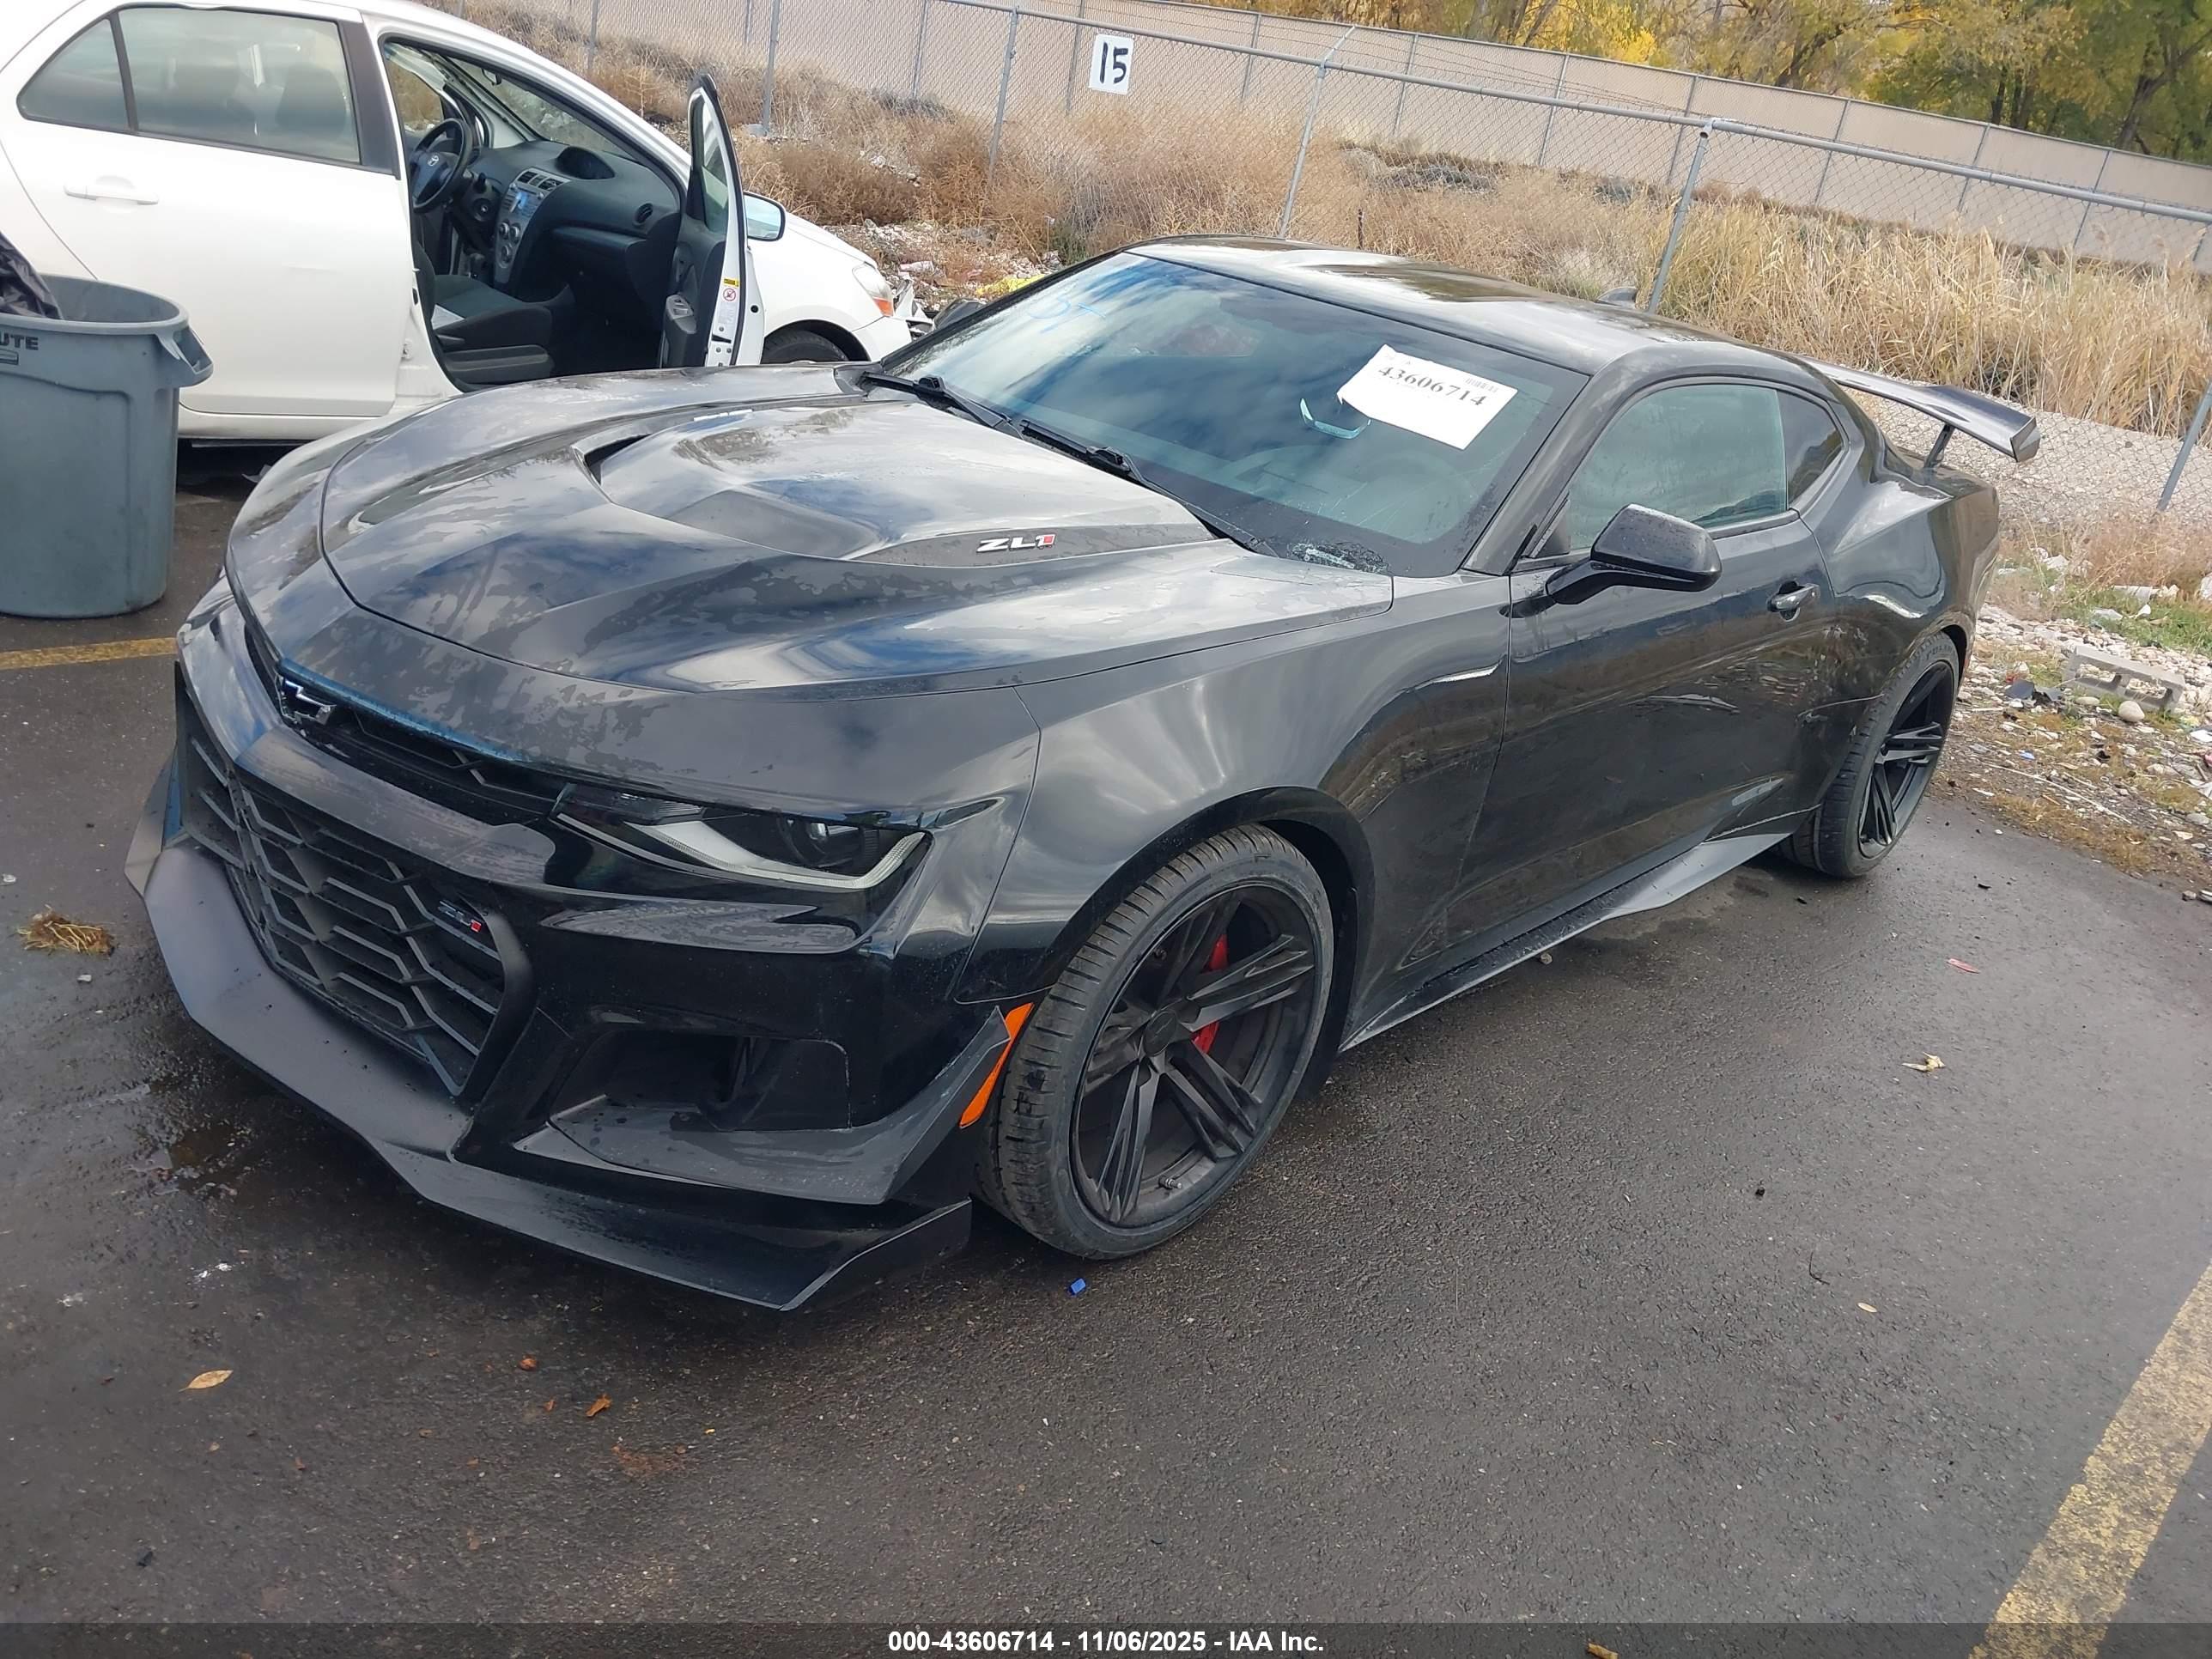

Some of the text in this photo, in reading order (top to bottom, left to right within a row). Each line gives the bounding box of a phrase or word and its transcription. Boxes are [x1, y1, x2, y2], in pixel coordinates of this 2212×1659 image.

[1100, 41, 1129, 84] 15
[1377, 366, 1487, 406] 43606714
[976, 533, 1056, 554] ZL1
